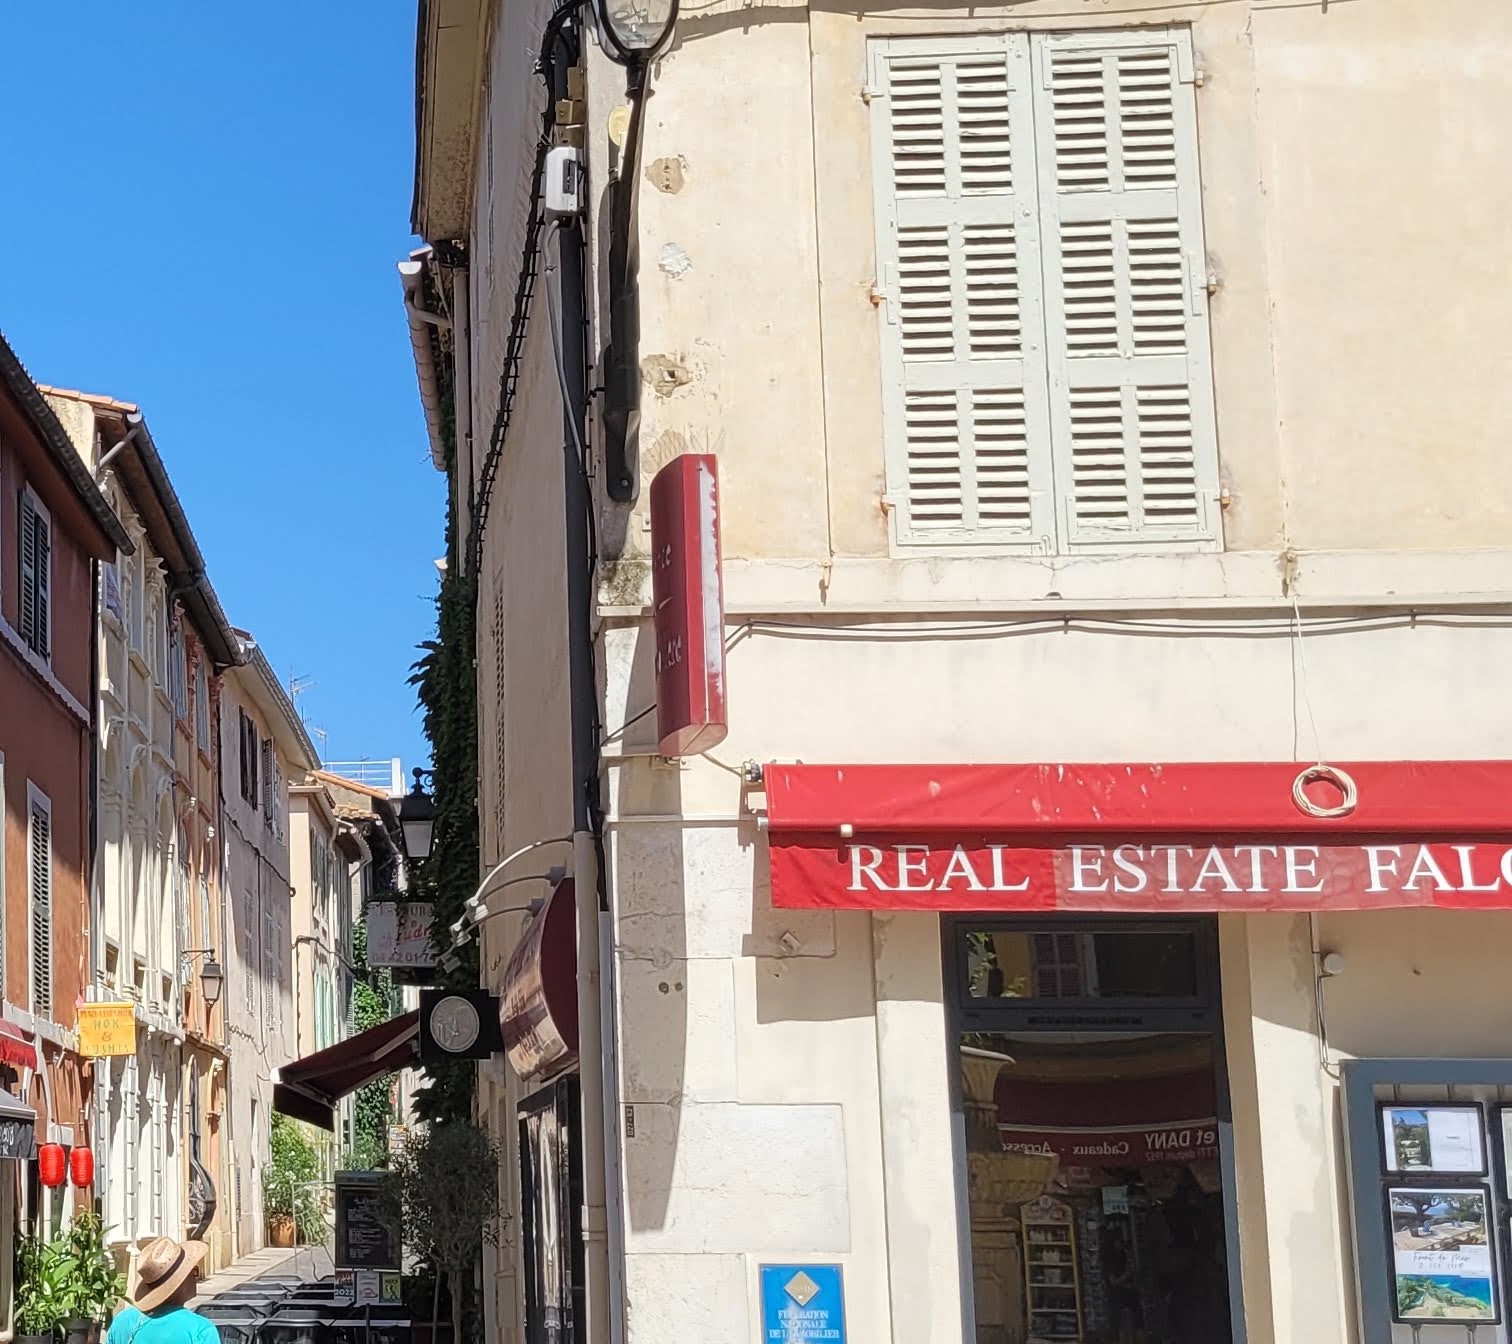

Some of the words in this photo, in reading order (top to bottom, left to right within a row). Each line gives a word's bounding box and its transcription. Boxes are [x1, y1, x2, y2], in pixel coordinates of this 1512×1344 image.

[845, 843, 1030, 891] REAL
[1066, 843, 1325, 893] ESTATE
[101, 1032, 112, 1041] &
